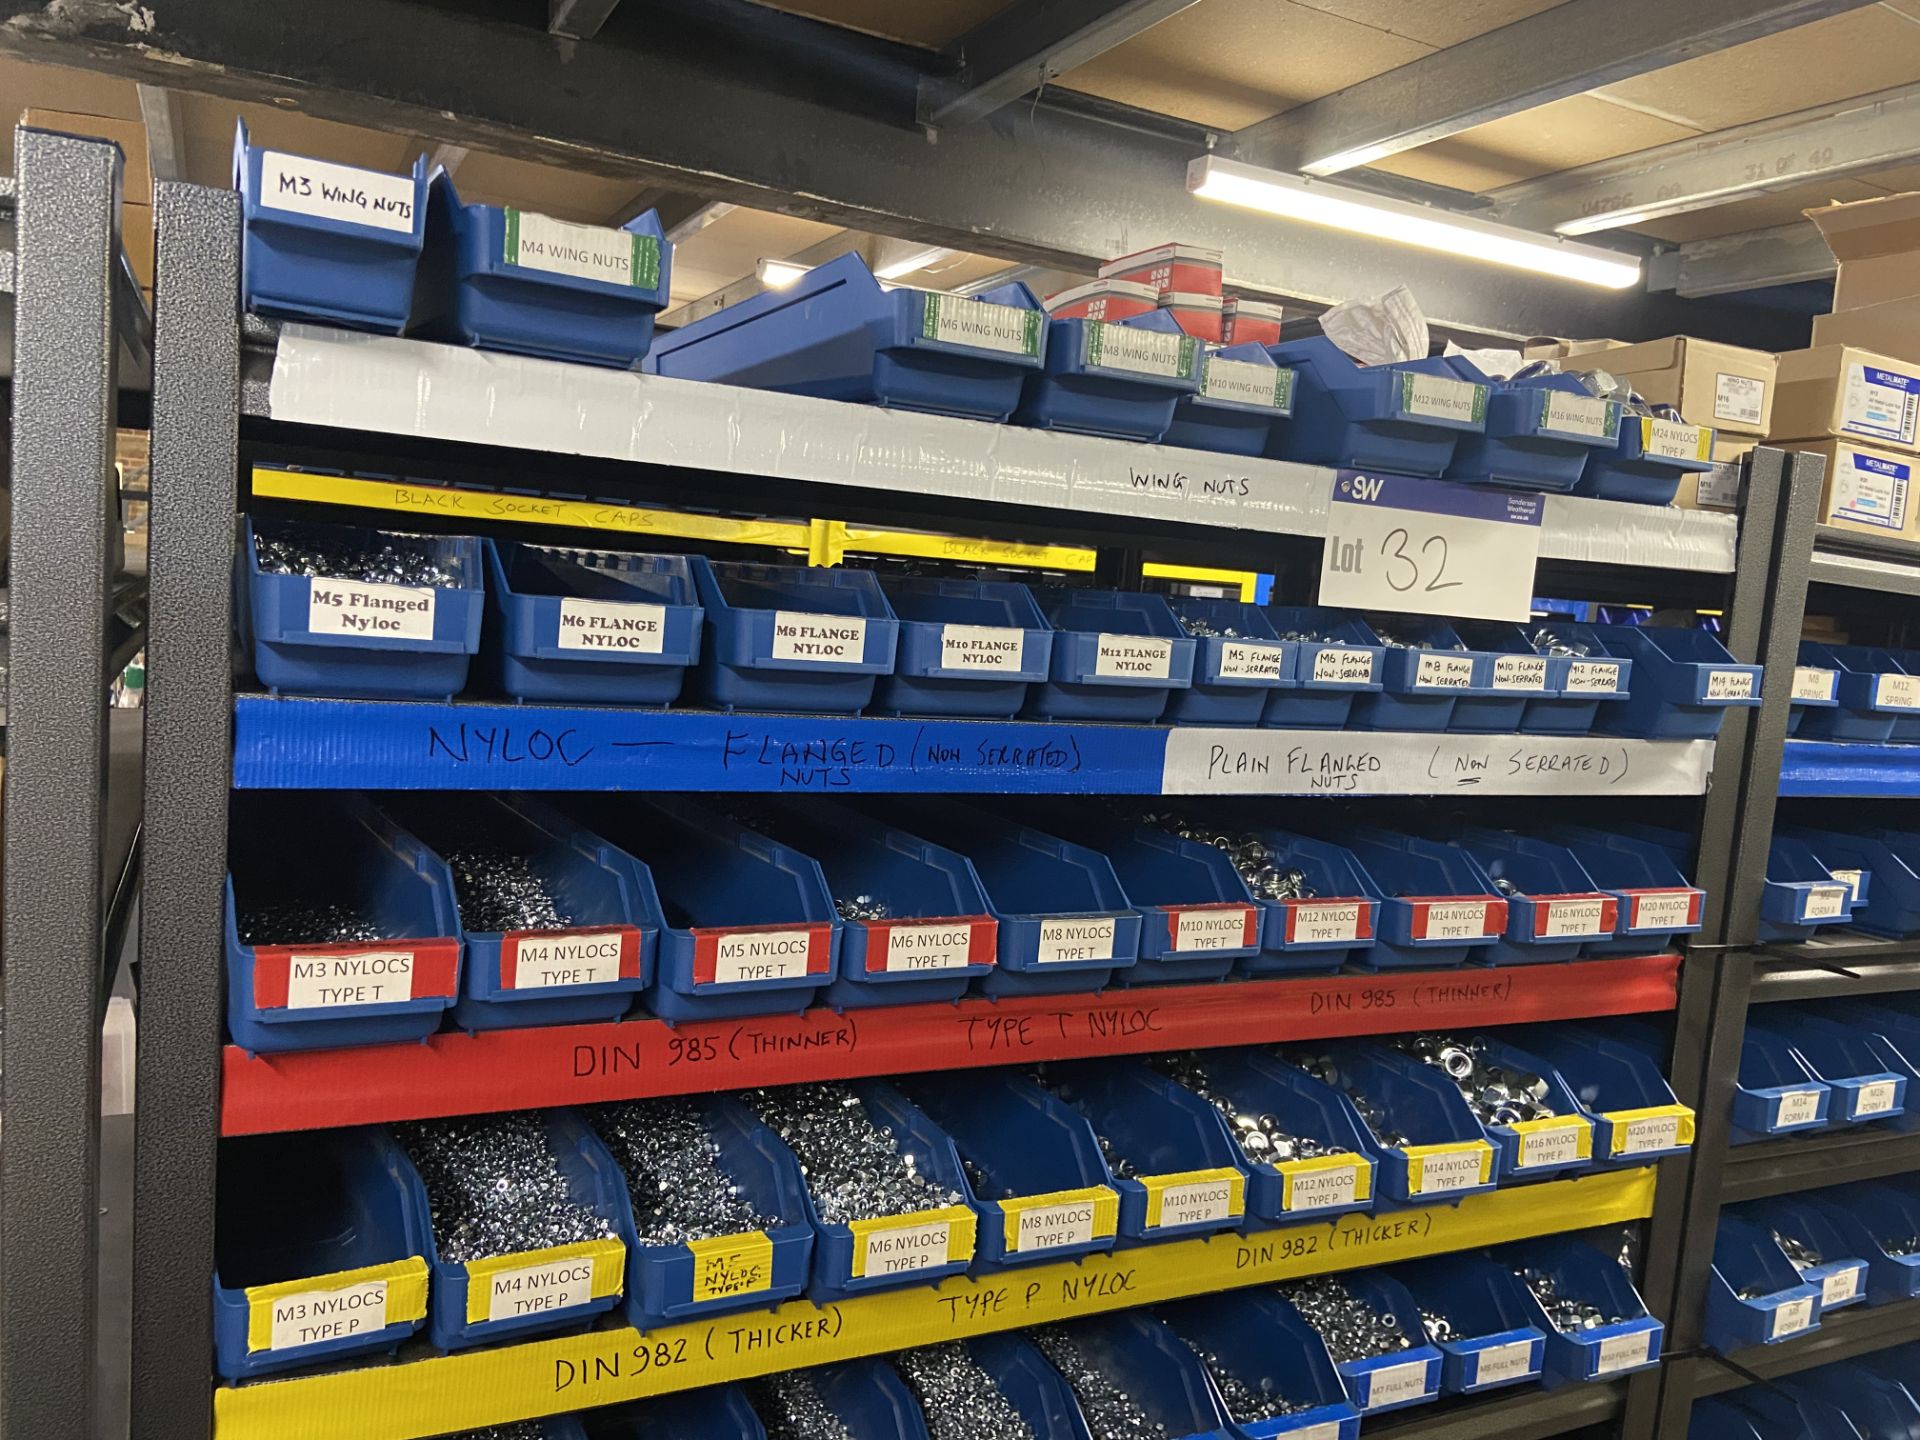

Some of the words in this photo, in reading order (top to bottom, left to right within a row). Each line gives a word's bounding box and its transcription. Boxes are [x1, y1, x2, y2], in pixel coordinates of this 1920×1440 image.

[280, 173, 311, 196] M3
[322, 182, 366, 208] WING
[374, 195, 412, 219] NUTS
[522, 240, 544, 255] M4
[548, 244, 589, 263] WING
[592, 251, 629, 270] NUTS
[941, 317, 957, 331] M6
[961, 322, 991, 337] WING
[994, 326, 1022, 341] NUTS
[1103, 344, 1120, 357] M8
[1123, 347, 1149, 362] WING
[1152, 352, 1177, 365] NUTS
[1209, 377, 1227, 389] M10
[1230, 380, 1251, 393] WING
[1253, 384, 1273, 396] NUTS
[1414, 393, 1430, 405] M12
[1431, 395, 1450, 408] WING
[1452, 399, 1471, 411] NUTS
[1550, 410, 1564, 422] M16
[1566, 412, 1584, 425] WING
[1586, 415, 1603, 427] NUTS
[1651, 426, 1668, 440] M24
[1669, 430, 1698, 444] NYLOCS
[1130, 467, 1186, 490] WING
[1204, 478, 1249, 495] NUTS
[1352, 476, 1384, 501] SW
[395, 489, 465, 510] BLACK
[489, 499, 566, 519] SOCKET
[594, 510, 654, 527] CAPS
[943, 541, 988, 555] BLACK
[1330, 536, 1364, 574] Lot
[1381, 528, 1463, 591] 32
[313, 589, 343, 607] M5
[348, 592, 429, 614] Flanged
[342, 614, 401, 632] Nyloc
[562, 614, 585, 629] M6
[589, 617, 658, 633] FLANGE
[581, 633, 640, 649] NYLOC
[776, 624, 797, 640] M8
[800, 627, 860, 642] FLANGE
[793, 642, 844, 657] NYLOC
[945, 638, 969, 651] M10
[972, 639, 1018, 653] FLANGE
[1100, 647, 1122, 659] M12
[1125, 648, 1167, 661] FLANGE
[962, 652, 1003, 665] NYLOC
[1229, 650, 1244, 661] M5
[1251, 652, 1281, 664] FLANGE
[1320, 653, 1336, 664] M6
[1342, 653, 1372, 665] FLANGE
[1115, 660, 1153, 673] NYLOC
[1497, 662, 1513, 671] M10
[1800, 690, 1823, 699] SPRING
[1893, 680, 1910, 691] M12
[1885, 696, 1912, 706] SPRING
[430, 725, 595, 765] NYLOC
[722, 734, 895, 768] FLANGED
[1209, 745, 1269, 780] PLAIN
[1287, 746, 1381, 773] FLANGED
[780, 768, 851, 788] NUTS
[1311, 774, 1358, 790] NUTS
[1297, 911, 1319, 923] M12
[1321, 909, 1356, 922] NYLOCS
[1429, 909, 1449, 921] M14
[1451, 908, 1484, 921] NYLOCS
[1549, 908, 1568, 920] M16
[1570, 906, 1601, 918] NYLOCS
[1640, 902, 1658, 914] M20
[1660, 901, 1688, 913] NYLOCS
[1043, 928, 1063, 941] M8
[1066, 926, 1112, 939] NYLOCS
[1180, 920, 1201, 933] M10
[1204, 918, 1244, 931] NYLOCS
[720, 943, 745, 958] M5
[749, 940, 806, 956] NYLOCS
[891, 935, 914, 949] M6
[917, 932, 968, 947] NYLOCS
[521, 947, 548, 963] M4
[554, 943, 618, 960] NYLOCS
[294, 962, 326, 979] M3
[334, 958, 410, 977] NYLOCS
[541, 970, 582, 985] TYPE
[585, 968, 596, 982] T
[319, 986, 365, 1003] TYPE
[370, 985, 384, 1001] T
[1311, 992, 1352, 1015] DIN
[1362, 989, 1395, 1009] 985
[958, 1015, 1034, 1051] TYPE
[1047, 1012, 1073, 1039] T
[1088, 1007, 1162, 1037] NYLOC
[574, 1042, 640, 1077] DIN
[668, 1035, 720, 1066] 985
[729, 1019, 856, 1060] (THINNER)
[1526, 1138, 1544, 1149] M16
[1545, 1134, 1577, 1147] NYLOCS
[1424, 1162, 1443, 1173] M14
[1445, 1159, 1480, 1172] NYLOCS
[1294, 1180, 1314, 1191] M12
[1317, 1175, 1354, 1189] NYLOCS
[1163, 1195, 1187, 1206] M10
[1189, 1189, 1228, 1204] NYLOCS
[1022, 1216, 1042, 1231] M8
[1044, 1210, 1092, 1228] NYLOCS
[869, 1237, 893, 1255] M6
[896, 1231, 947, 1250] NYLOCS
[1236, 1244, 1275, 1270] DIN
[1280, 1236, 1317, 1259] 982
[1329, 1213, 1431, 1250] (THICKER)
[495, 1278, 522, 1295] M4
[527, 1266, 590, 1289] NYLOCS
[705, 1265, 760, 1286] NYLOC
[515, 1298, 554, 1314] TYPE
[559, 1293, 568, 1307] P
[938, 1288, 1006, 1322] TYPE
[1024, 1282, 1040, 1308] P
[1062, 1270, 1137, 1302] NYLOC
[277, 1304, 306, 1323] M3
[313, 1290, 384, 1316] NYLOCS
[300, 1323, 343, 1343] TYPE
[349, 1319, 360, 1334] P
[555, 1352, 618, 1392] DIN
[632, 1339, 688, 1376] 982
[1493, 1359, 1509, 1372] FULL
[1510, 1355, 1529, 1369] NUTS
[1386, 1382, 1404, 1394] FULL
[1404, 1377, 1425, 1391] NUTS
